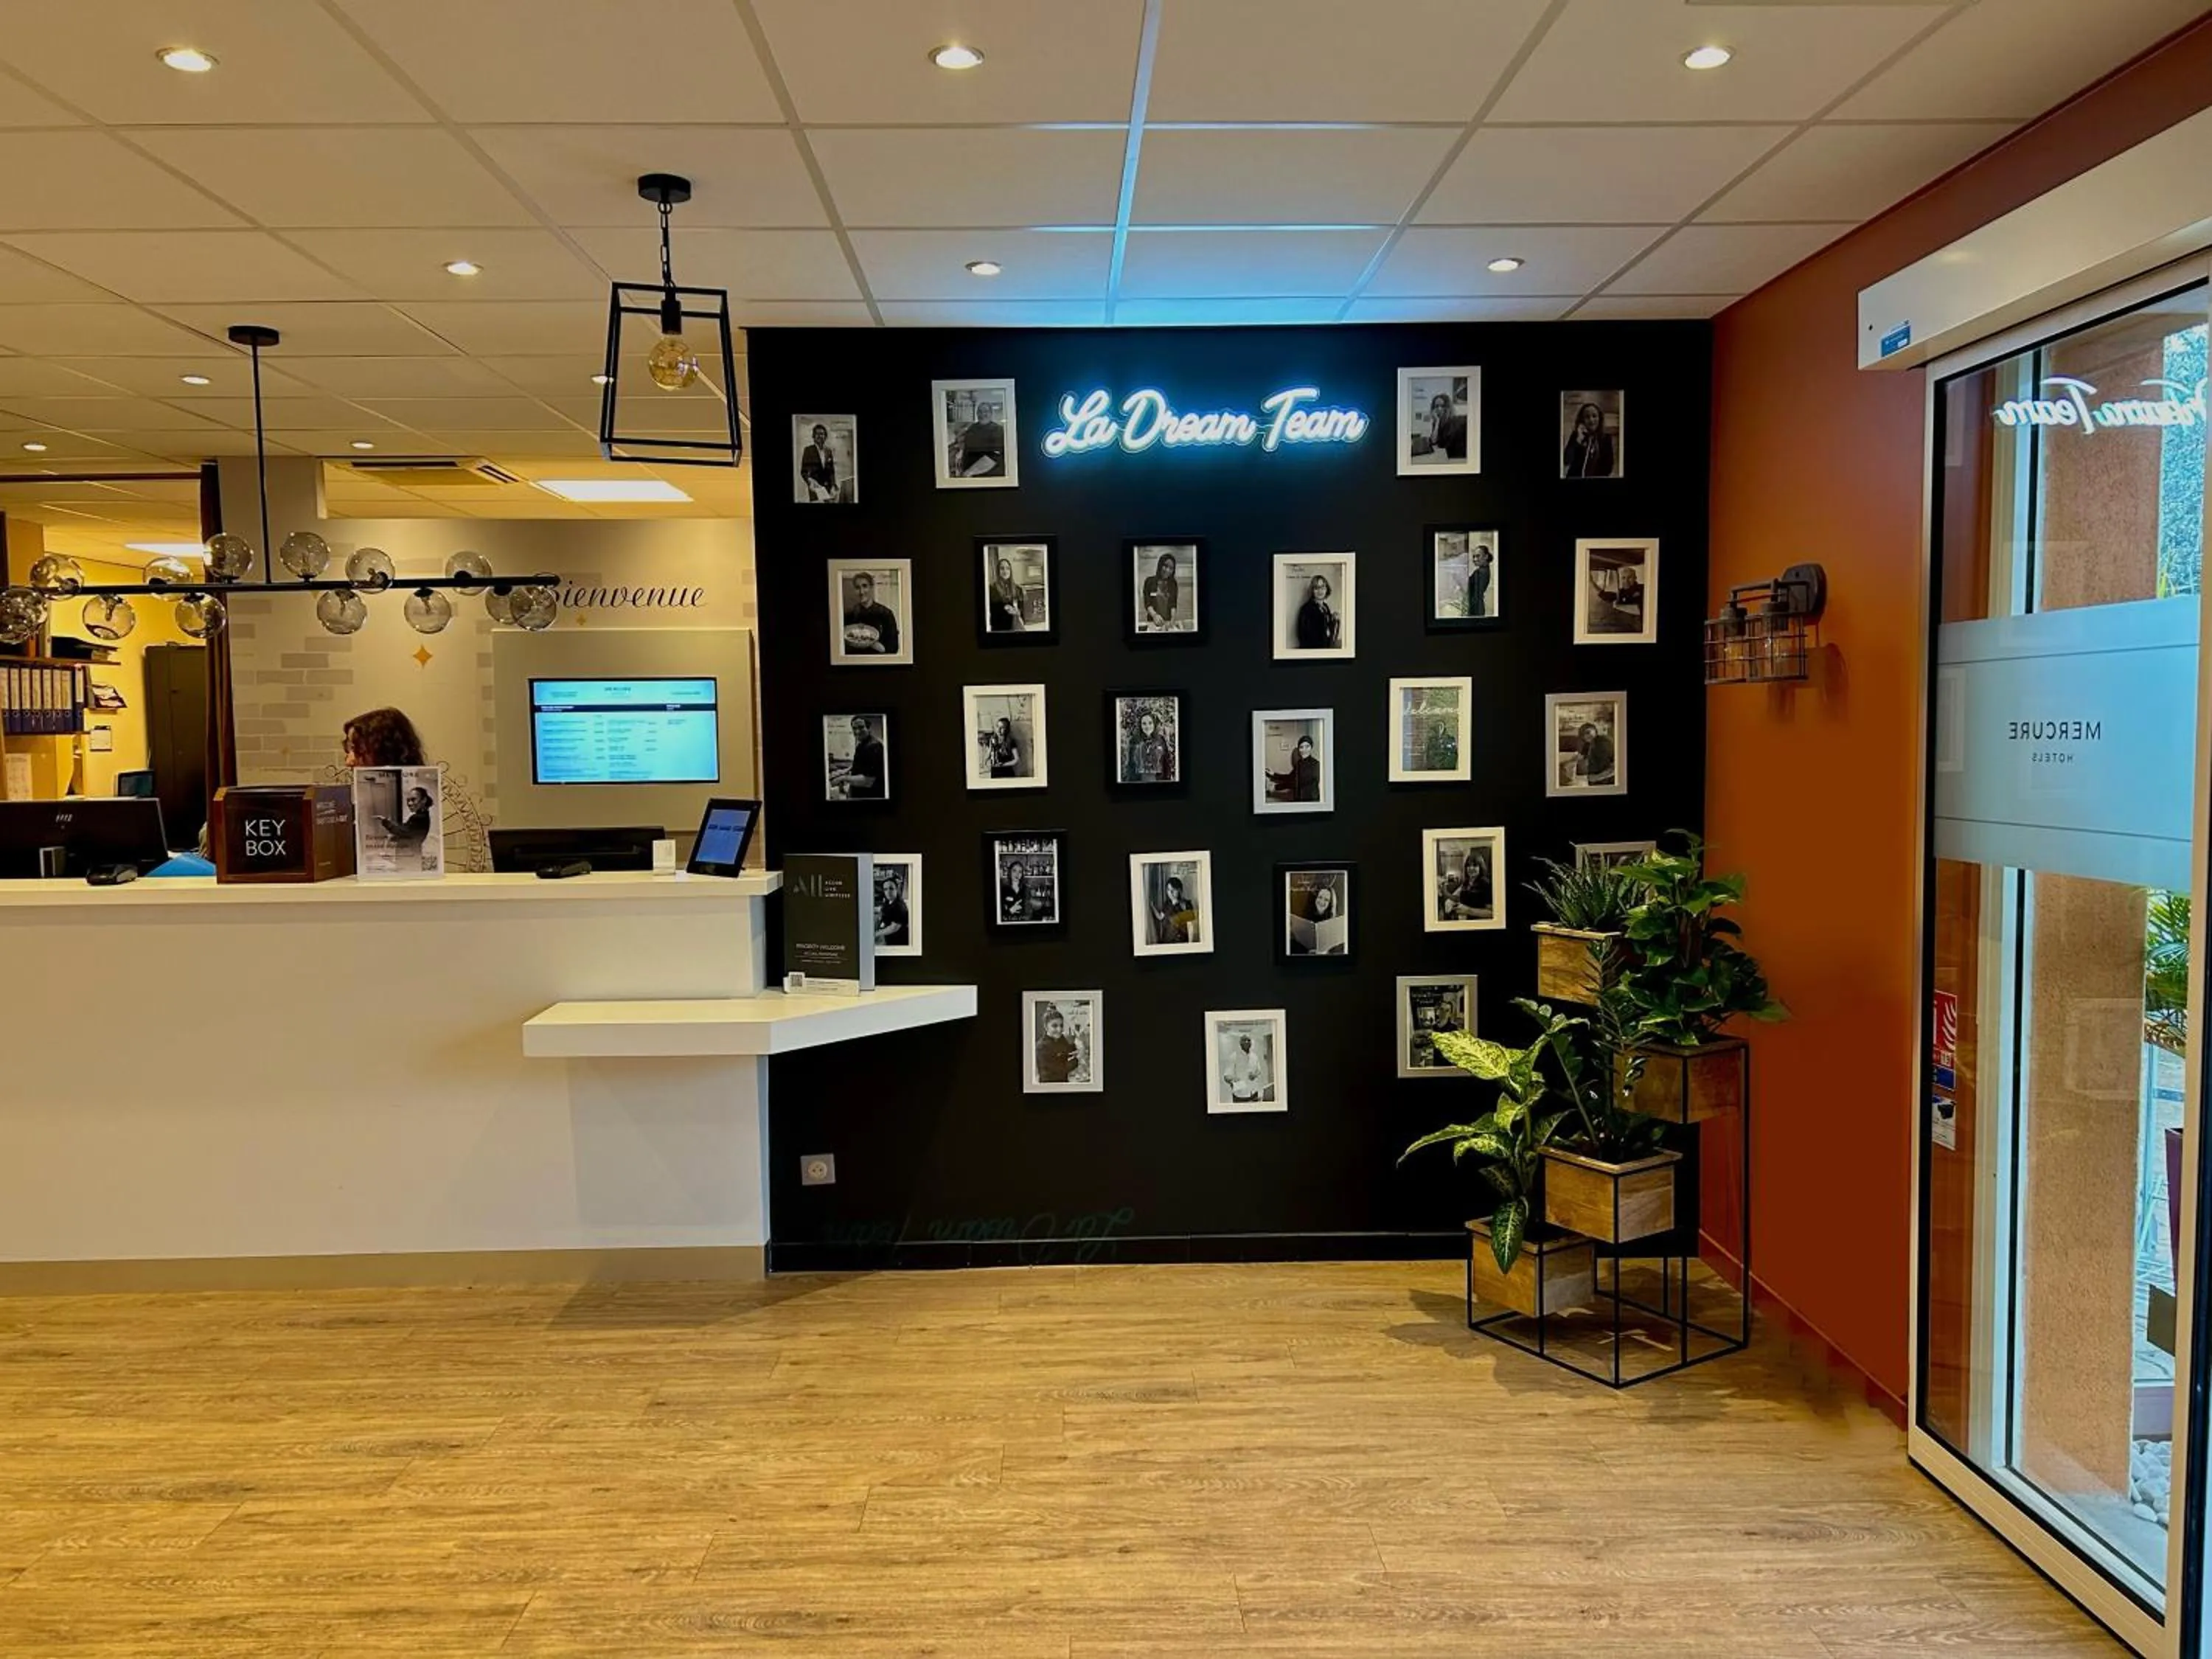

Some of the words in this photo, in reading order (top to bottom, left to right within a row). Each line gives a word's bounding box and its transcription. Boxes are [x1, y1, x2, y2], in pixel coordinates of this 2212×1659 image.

[1044, 389, 1118, 455] La
[1121, 389, 1256, 452] Dream
[1263, 387, 1368, 451] Team
[549, 580, 709, 608] ienvenue
[245, 819, 286, 837] KEY
[246, 840, 287, 856] BOX
